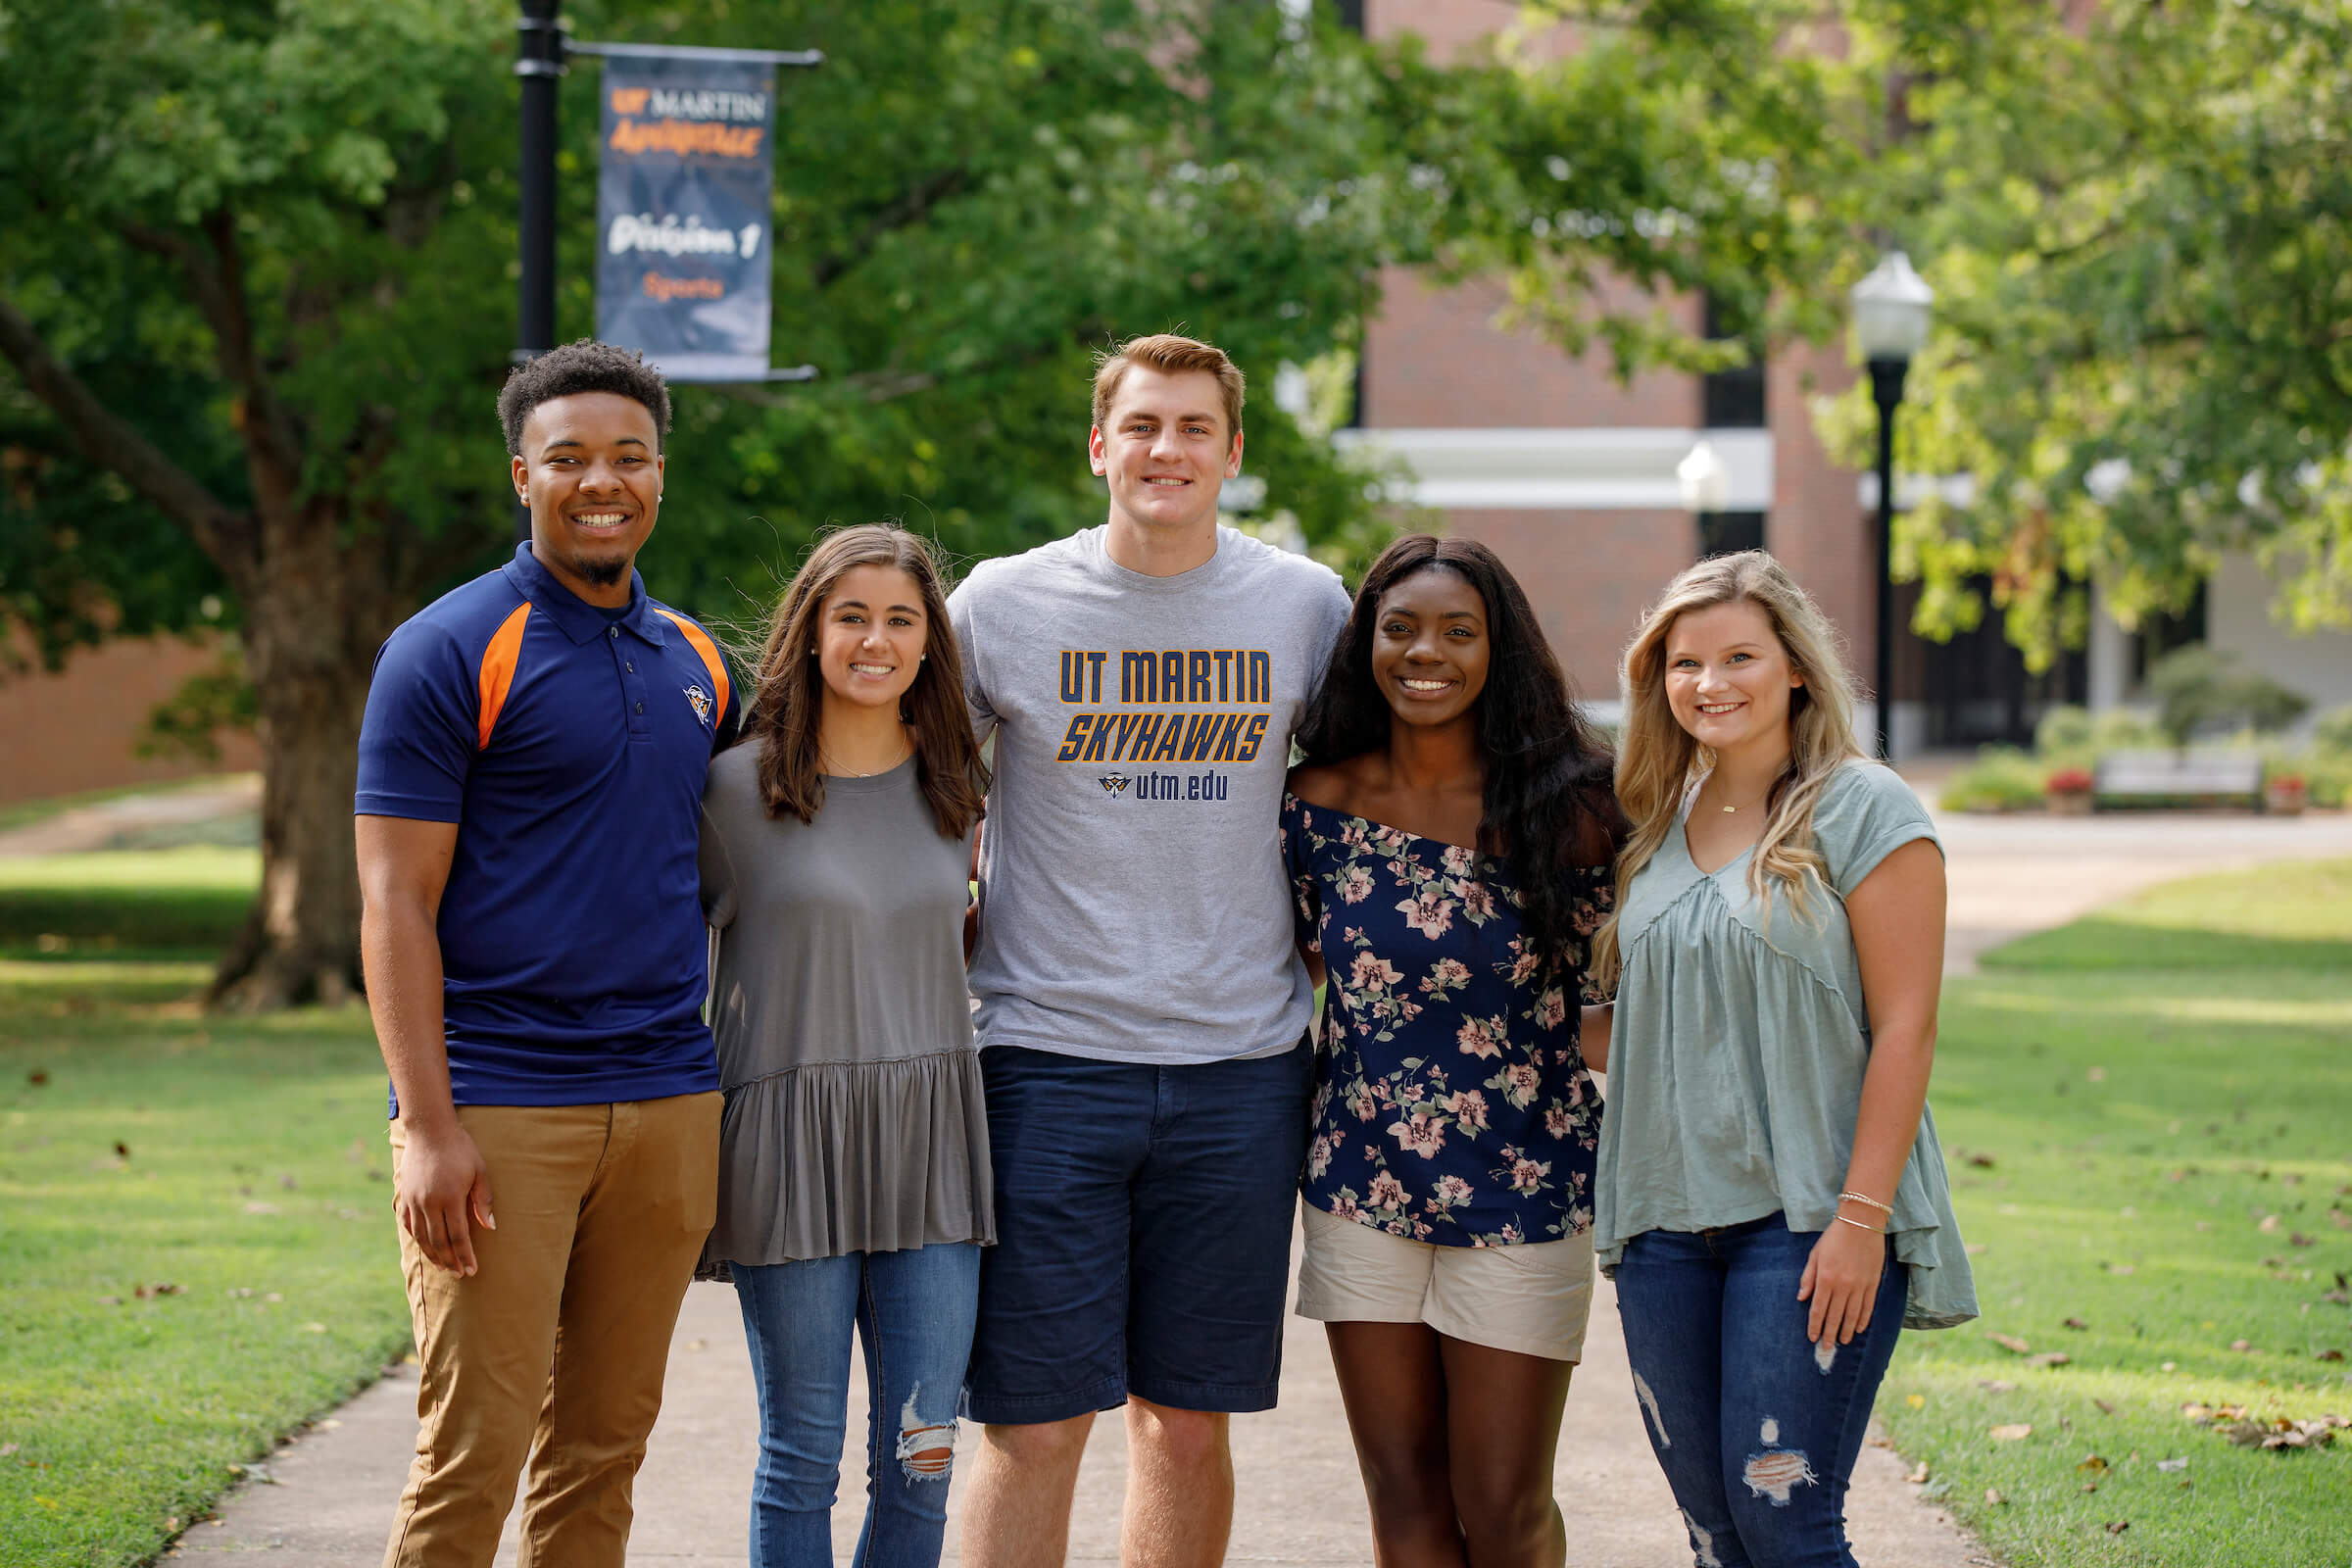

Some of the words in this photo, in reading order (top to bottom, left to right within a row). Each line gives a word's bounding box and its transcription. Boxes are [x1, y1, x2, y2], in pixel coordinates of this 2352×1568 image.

[612, 87, 650, 115] UT
[651, 89, 765, 120] MARTIN
[609, 213, 735, 257] Division
[739, 222, 761, 259] 1
[643, 271, 723, 302] Sports
[1059, 651, 1108, 704] UT
[1120, 651, 1271, 705] MARTIN
[1056, 713, 1271, 762] SKYHAWKS
[1136, 769, 1228, 801] utm.edu
